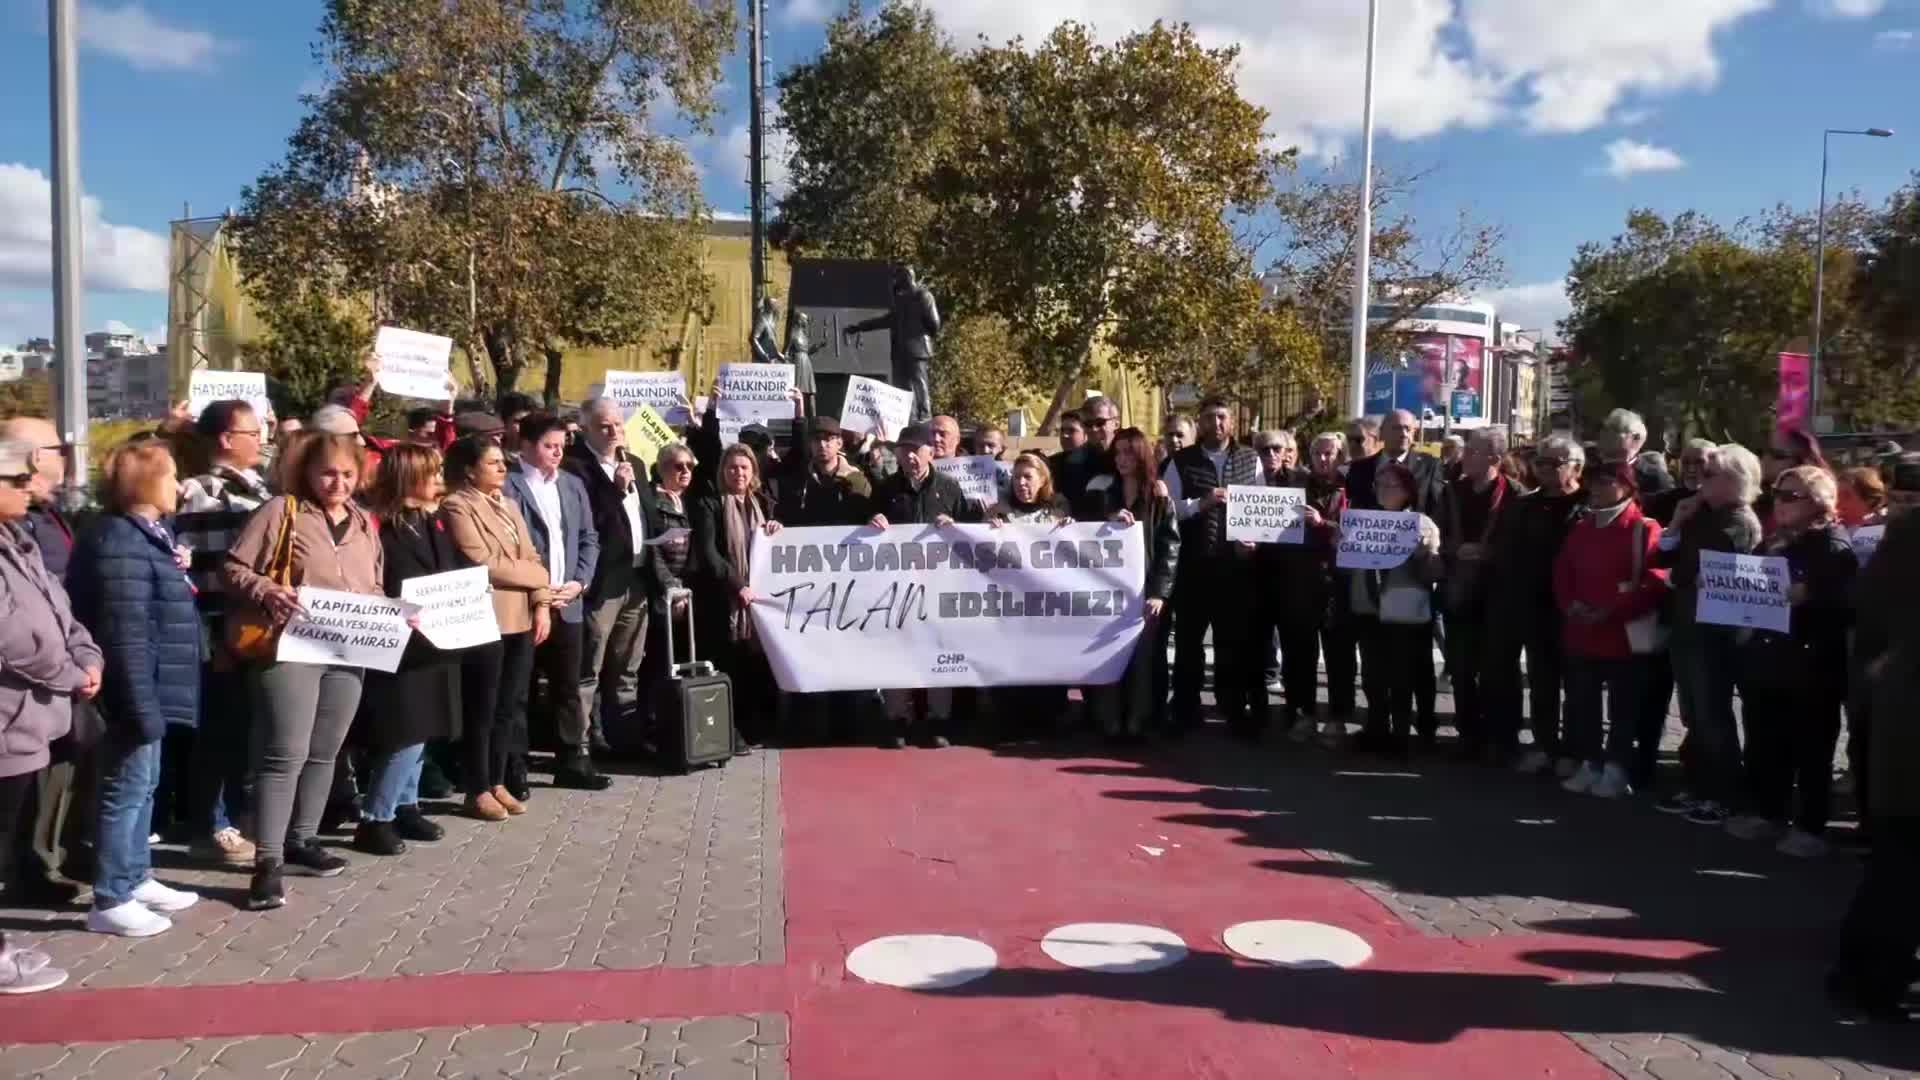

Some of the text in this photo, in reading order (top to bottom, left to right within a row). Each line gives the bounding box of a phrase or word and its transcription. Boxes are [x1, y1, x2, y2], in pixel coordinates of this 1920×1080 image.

[723, 380, 787, 392] HALKINDIR
[613, 387, 678, 398] HALKINDIR
[1243, 505, 1285, 517] GARDIR
[1228, 517, 1302, 529] GAR KALACAK
[1355, 531, 1398, 544] GARDIR
[1340, 542, 1361, 553] GAR
[772, 541, 1023, 573] HAYDARPAŞA
[1706, 575, 1780, 594] HALKINDIR
[311, 599, 401, 617] KAPİTALİSTİN
[770, 579, 1125, 634] TALAN EDİLEMEZ!
[291, 625, 349, 643] HALKIN
[937, 653, 966, 665] CHP
